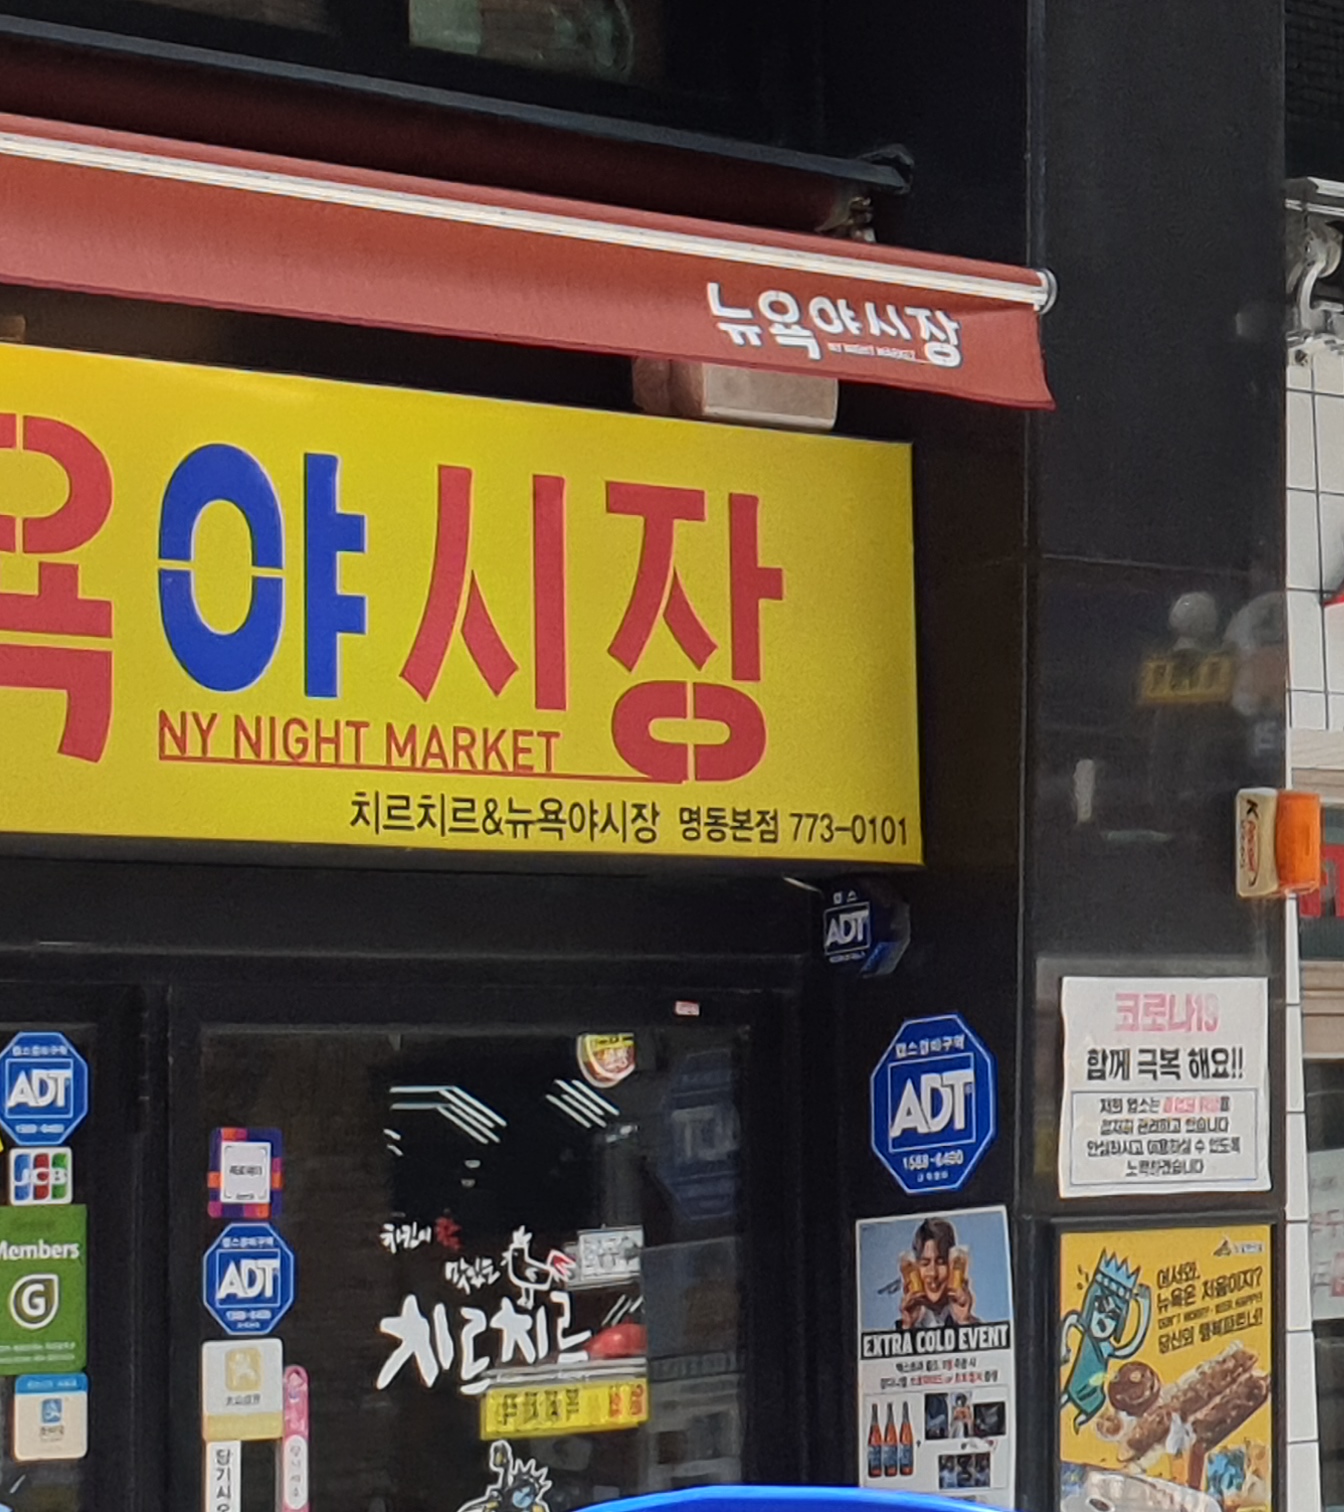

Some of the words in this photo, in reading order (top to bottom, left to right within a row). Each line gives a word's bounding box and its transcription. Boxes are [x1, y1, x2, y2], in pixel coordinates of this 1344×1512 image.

[707, 282, 961, 367] 뉴욕야시장
[158, 710, 218, 758] NY
[233, 715, 366, 765] NIGHT
[383, 723, 561, 774] MARKET
[348, 790, 661, 845] 치르치르&뉴욕야시장
[678, 805, 780, 844] 명동본점
[788, 812, 909, 846] 773-0101
[825, 909, 870, 946] ADT
[1114, 992, 1220, 1033] 코로나19
[1087, 1048, 1131, 1081] 함께
[1137, 1048, 1181, 1081] 극복
[1187, 1045, 1244, 1080] 해요!!
[7, 1068, 73, 1108] ADT
[889, 1068, 975, 1138] ADT
[15, 1168, 68, 1186] JCB
[217, 1258, 280, 1299] ADT
[376, 1291, 592, 1395] 치르치르
[863, 1331, 914, 1358] EXTRA
[916, 1327, 956, 1354] COLD
[958, 1324, 1009, 1350] EVENT
